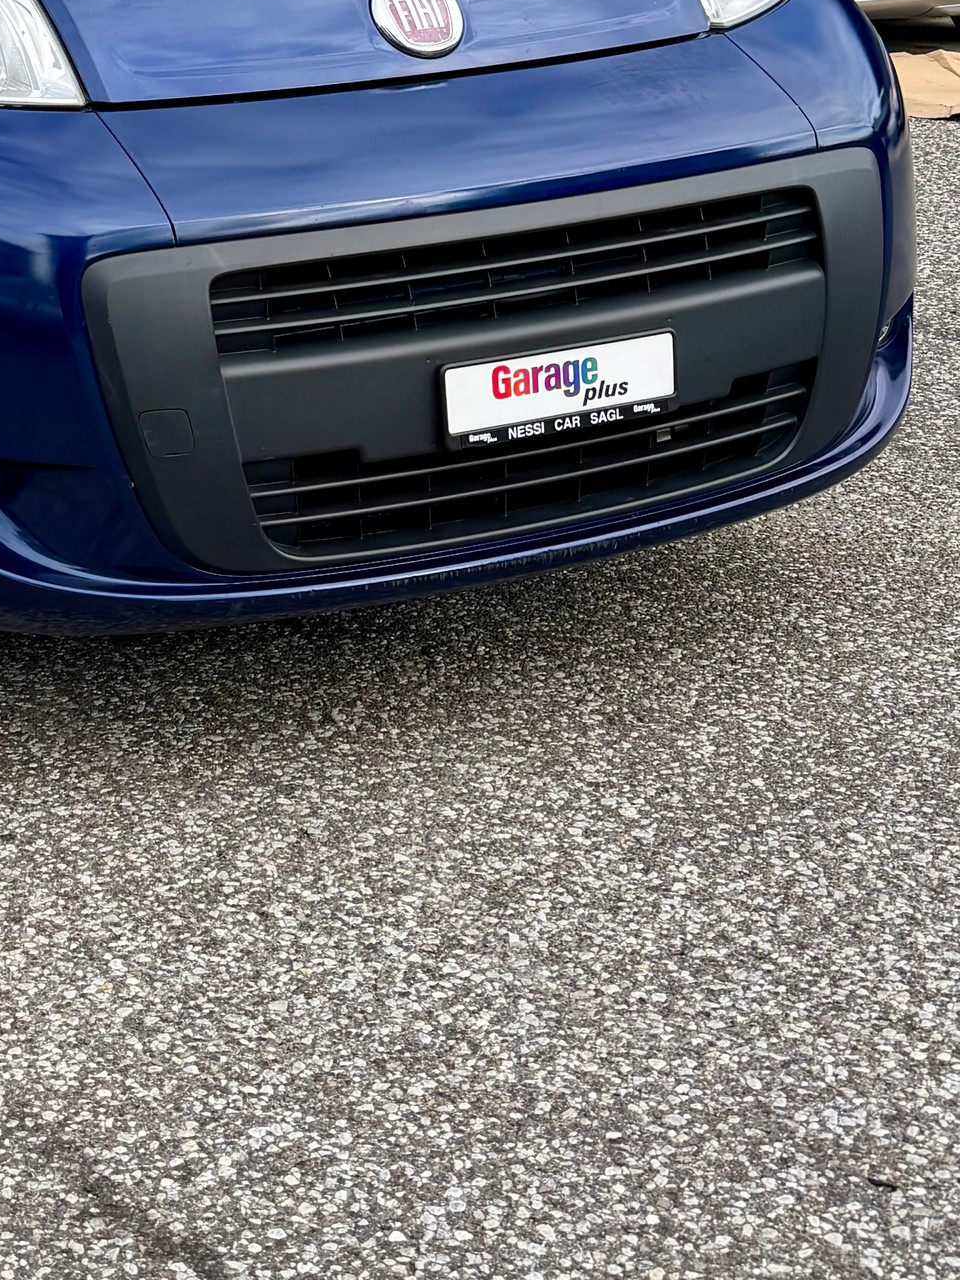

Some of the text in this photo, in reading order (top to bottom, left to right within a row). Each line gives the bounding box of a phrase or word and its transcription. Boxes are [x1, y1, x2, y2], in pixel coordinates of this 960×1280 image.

[491, 356, 599, 400] Garage
[582, 380, 629, 406] plus
[508, 408, 624, 440] NESSI CAR SAGL
